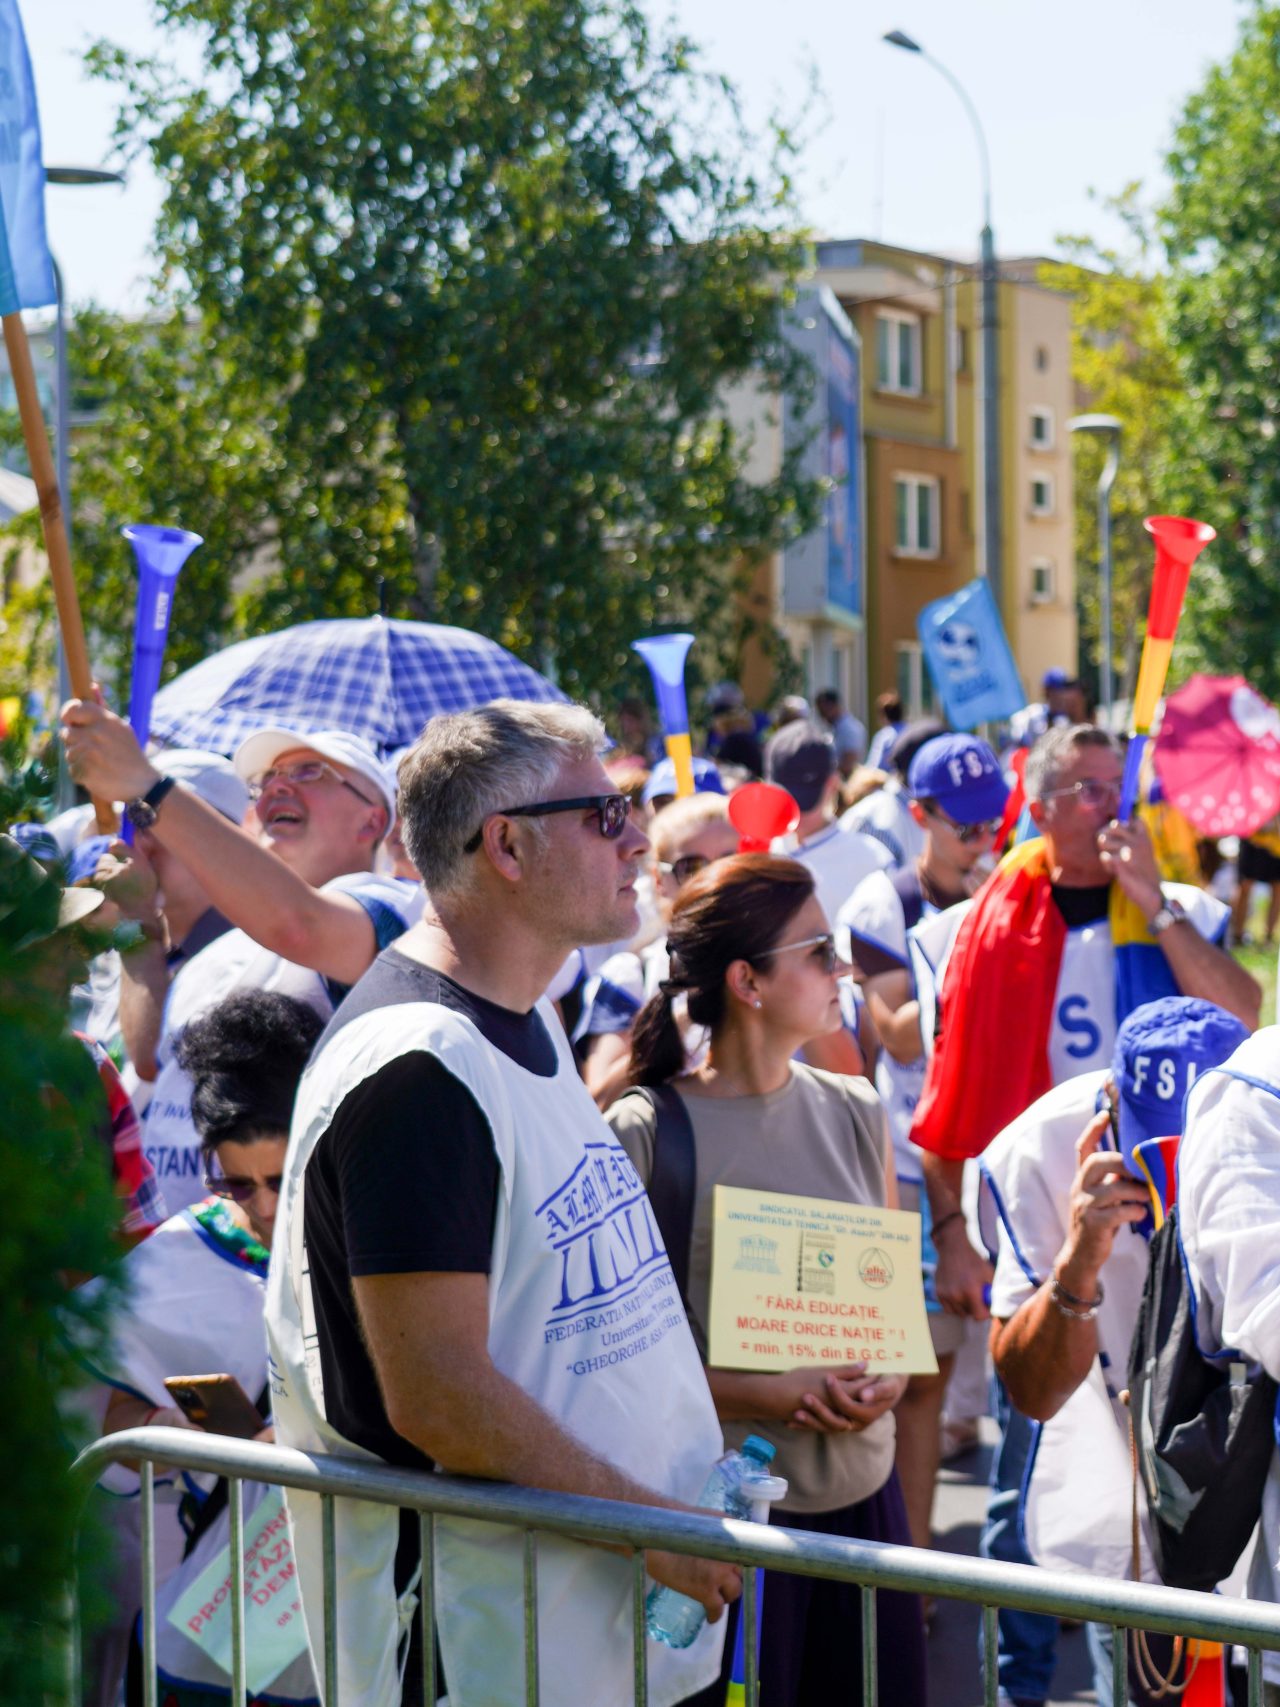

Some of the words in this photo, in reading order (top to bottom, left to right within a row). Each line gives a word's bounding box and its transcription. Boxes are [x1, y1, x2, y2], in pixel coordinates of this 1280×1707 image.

[736, 1316, 788, 1333] MOARE
[793, 1321, 837, 1338] ORICE
[821, 1346, 842, 1360] din
